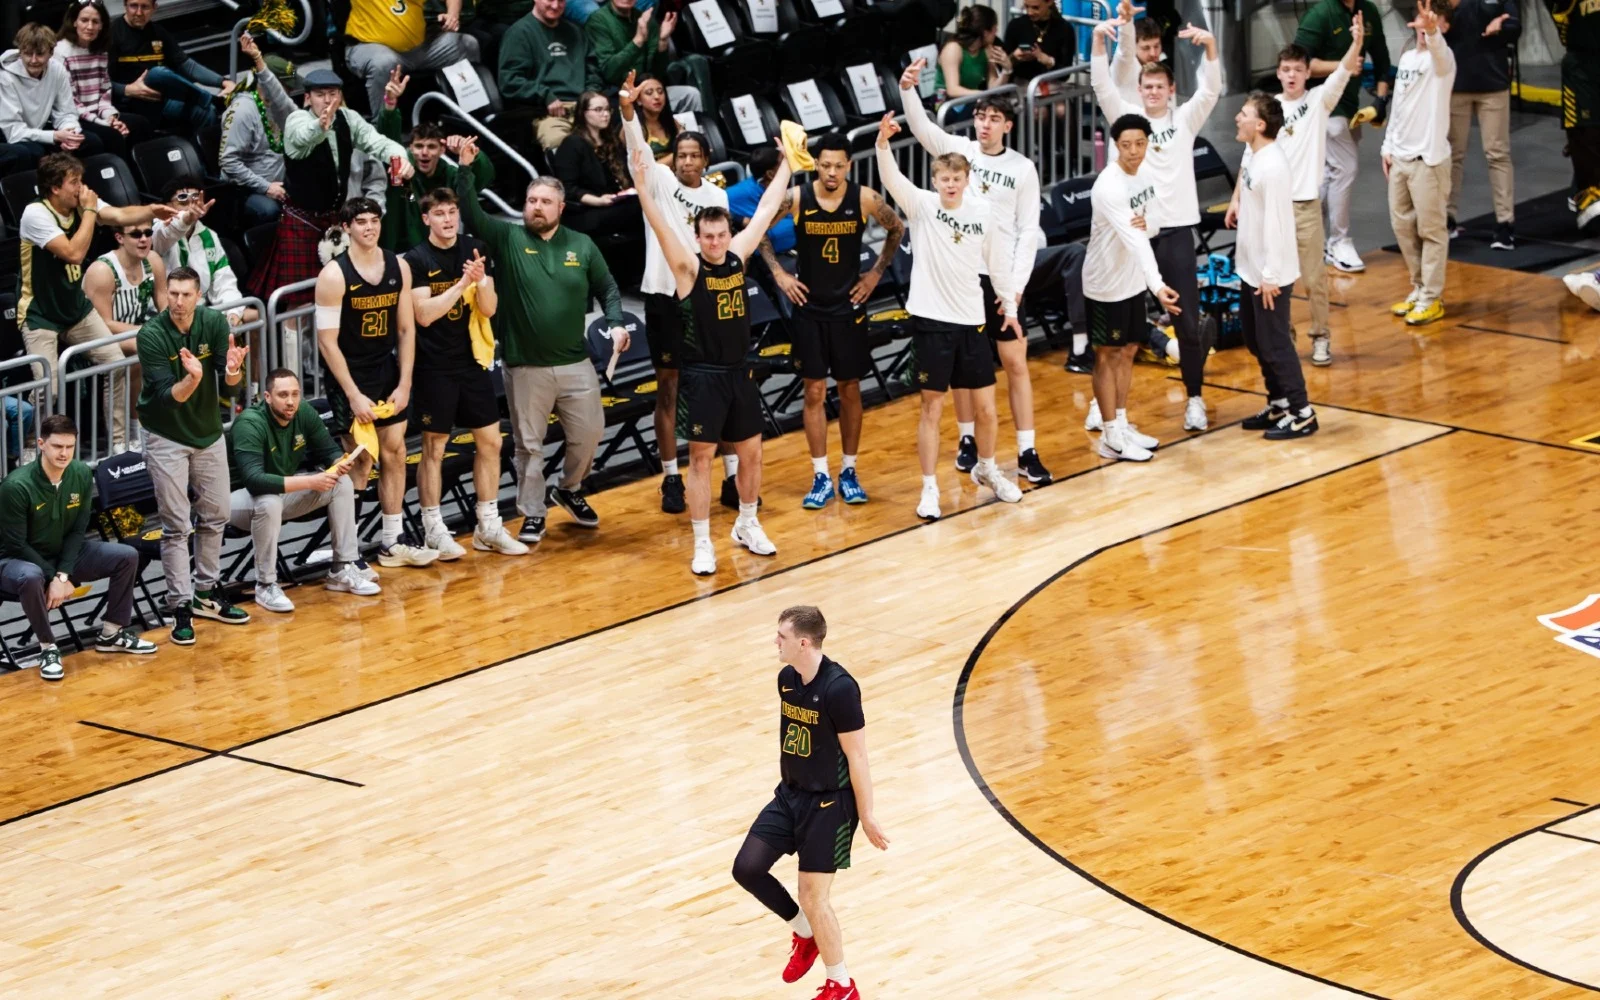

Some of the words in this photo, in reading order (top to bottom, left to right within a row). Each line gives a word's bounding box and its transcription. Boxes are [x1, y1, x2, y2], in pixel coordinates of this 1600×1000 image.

[991, 172, 1002, 184] IT
[804, 220, 858, 235] VERMONT
[936, 209, 960, 230] LOCK
[822, 237, 839, 263] 4
[65, 263, 81, 283] 18
[706, 271, 745, 291] VERMONT
[351, 291, 399, 310] VERMONT
[717, 290, 745, 320] 24
[361, 309, 388, 338] 21
[782, 722, 812, 758] 20
